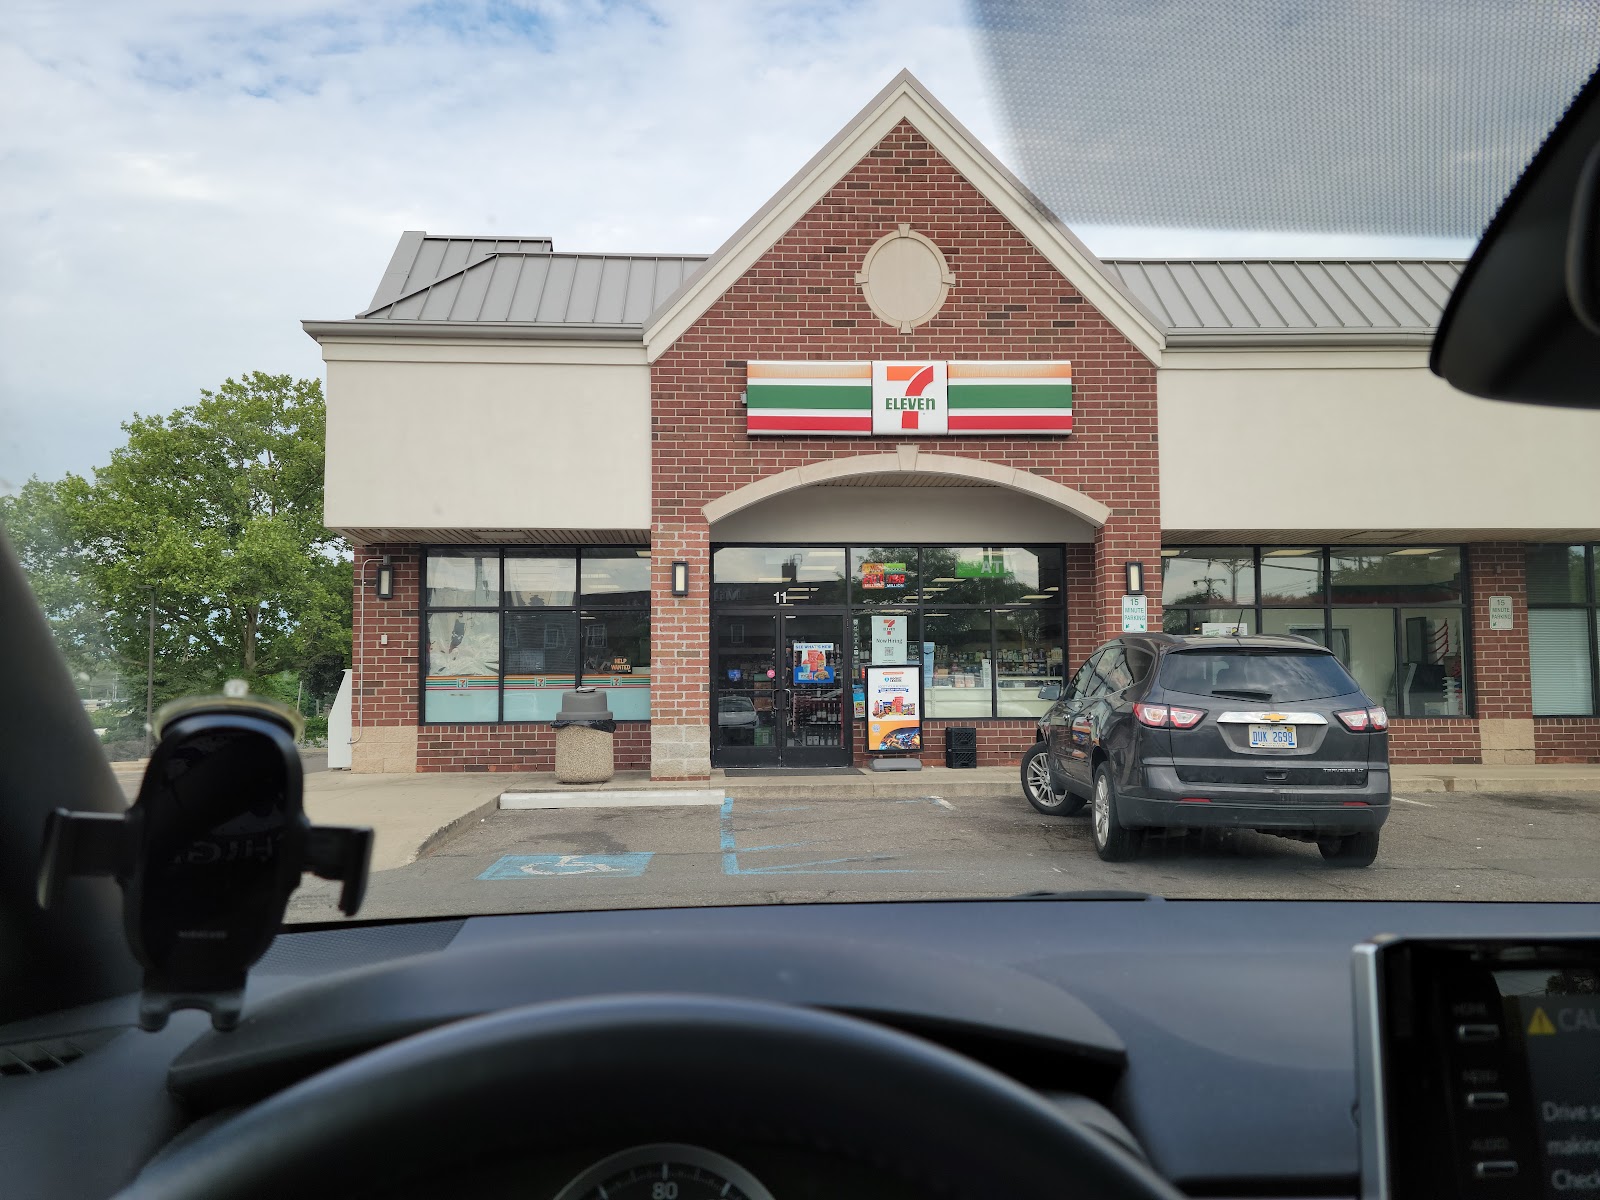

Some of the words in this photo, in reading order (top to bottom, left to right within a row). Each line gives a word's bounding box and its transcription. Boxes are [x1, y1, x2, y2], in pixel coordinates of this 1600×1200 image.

[886, 365, 934, 429] 7
[773, 591, 787, 604] 11
[1252, 731, 1268, 742] DUK
[651, 1181, 678, 1200] 80
